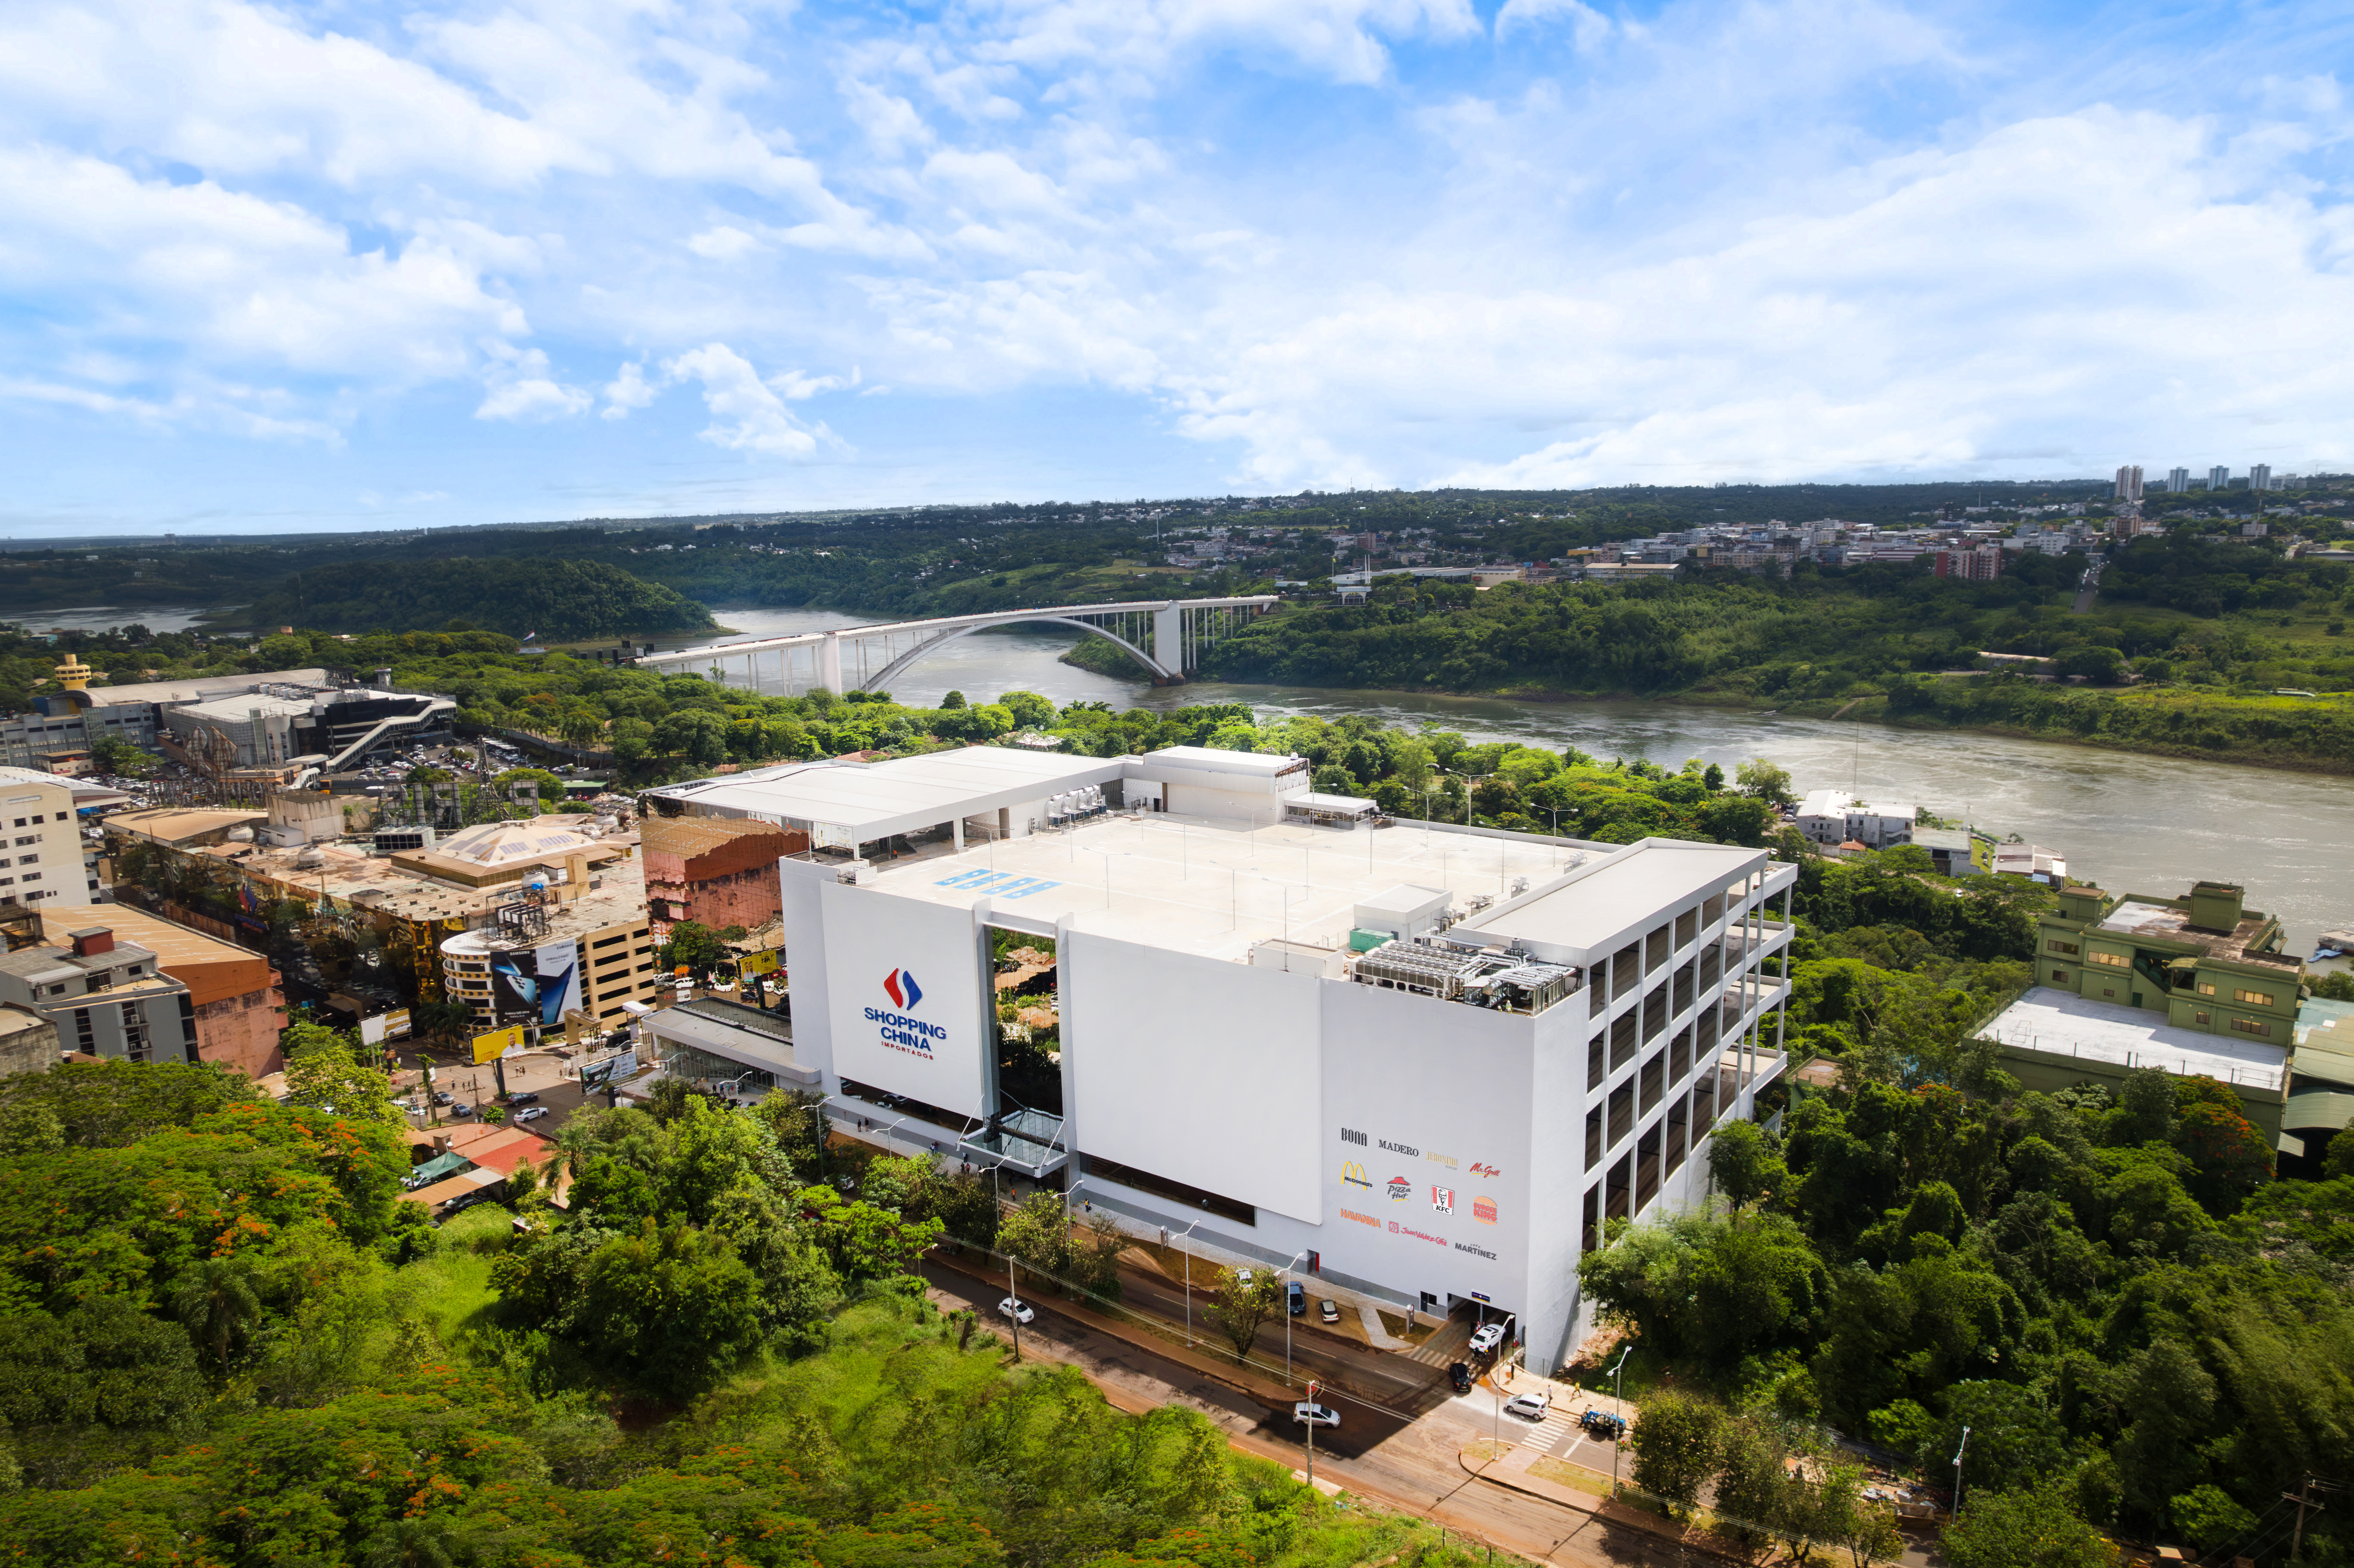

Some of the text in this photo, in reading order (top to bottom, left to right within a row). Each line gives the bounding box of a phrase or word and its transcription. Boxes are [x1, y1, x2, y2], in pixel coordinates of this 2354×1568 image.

[385, 1017, 409, 1026] EXCLUSIVO
[864, 1007, 947, 1039] SHOPPING
[881, 1027, 931, 1052] CHINA
[881, 1041, 934, 1060] IMPORTADOS
[1342, 1128, 1367, 1146] BONA
[1379, 1139, 1419, 1157] MADERO
[1426, 1151, 1457, 1167] JERONIMO
[1344, 1176, 1373, 1188] McDonald's
[1387, 1185, 1411, 1195] Pizza
[1473, 1202, 1497, 1213] BURGER
[1473, 1208, 1497, 1222] KING
[1340, 1208, 1381, 1228] HAVANNA
[1401, 1227, 1448, 1246] Juan Valdez Café
